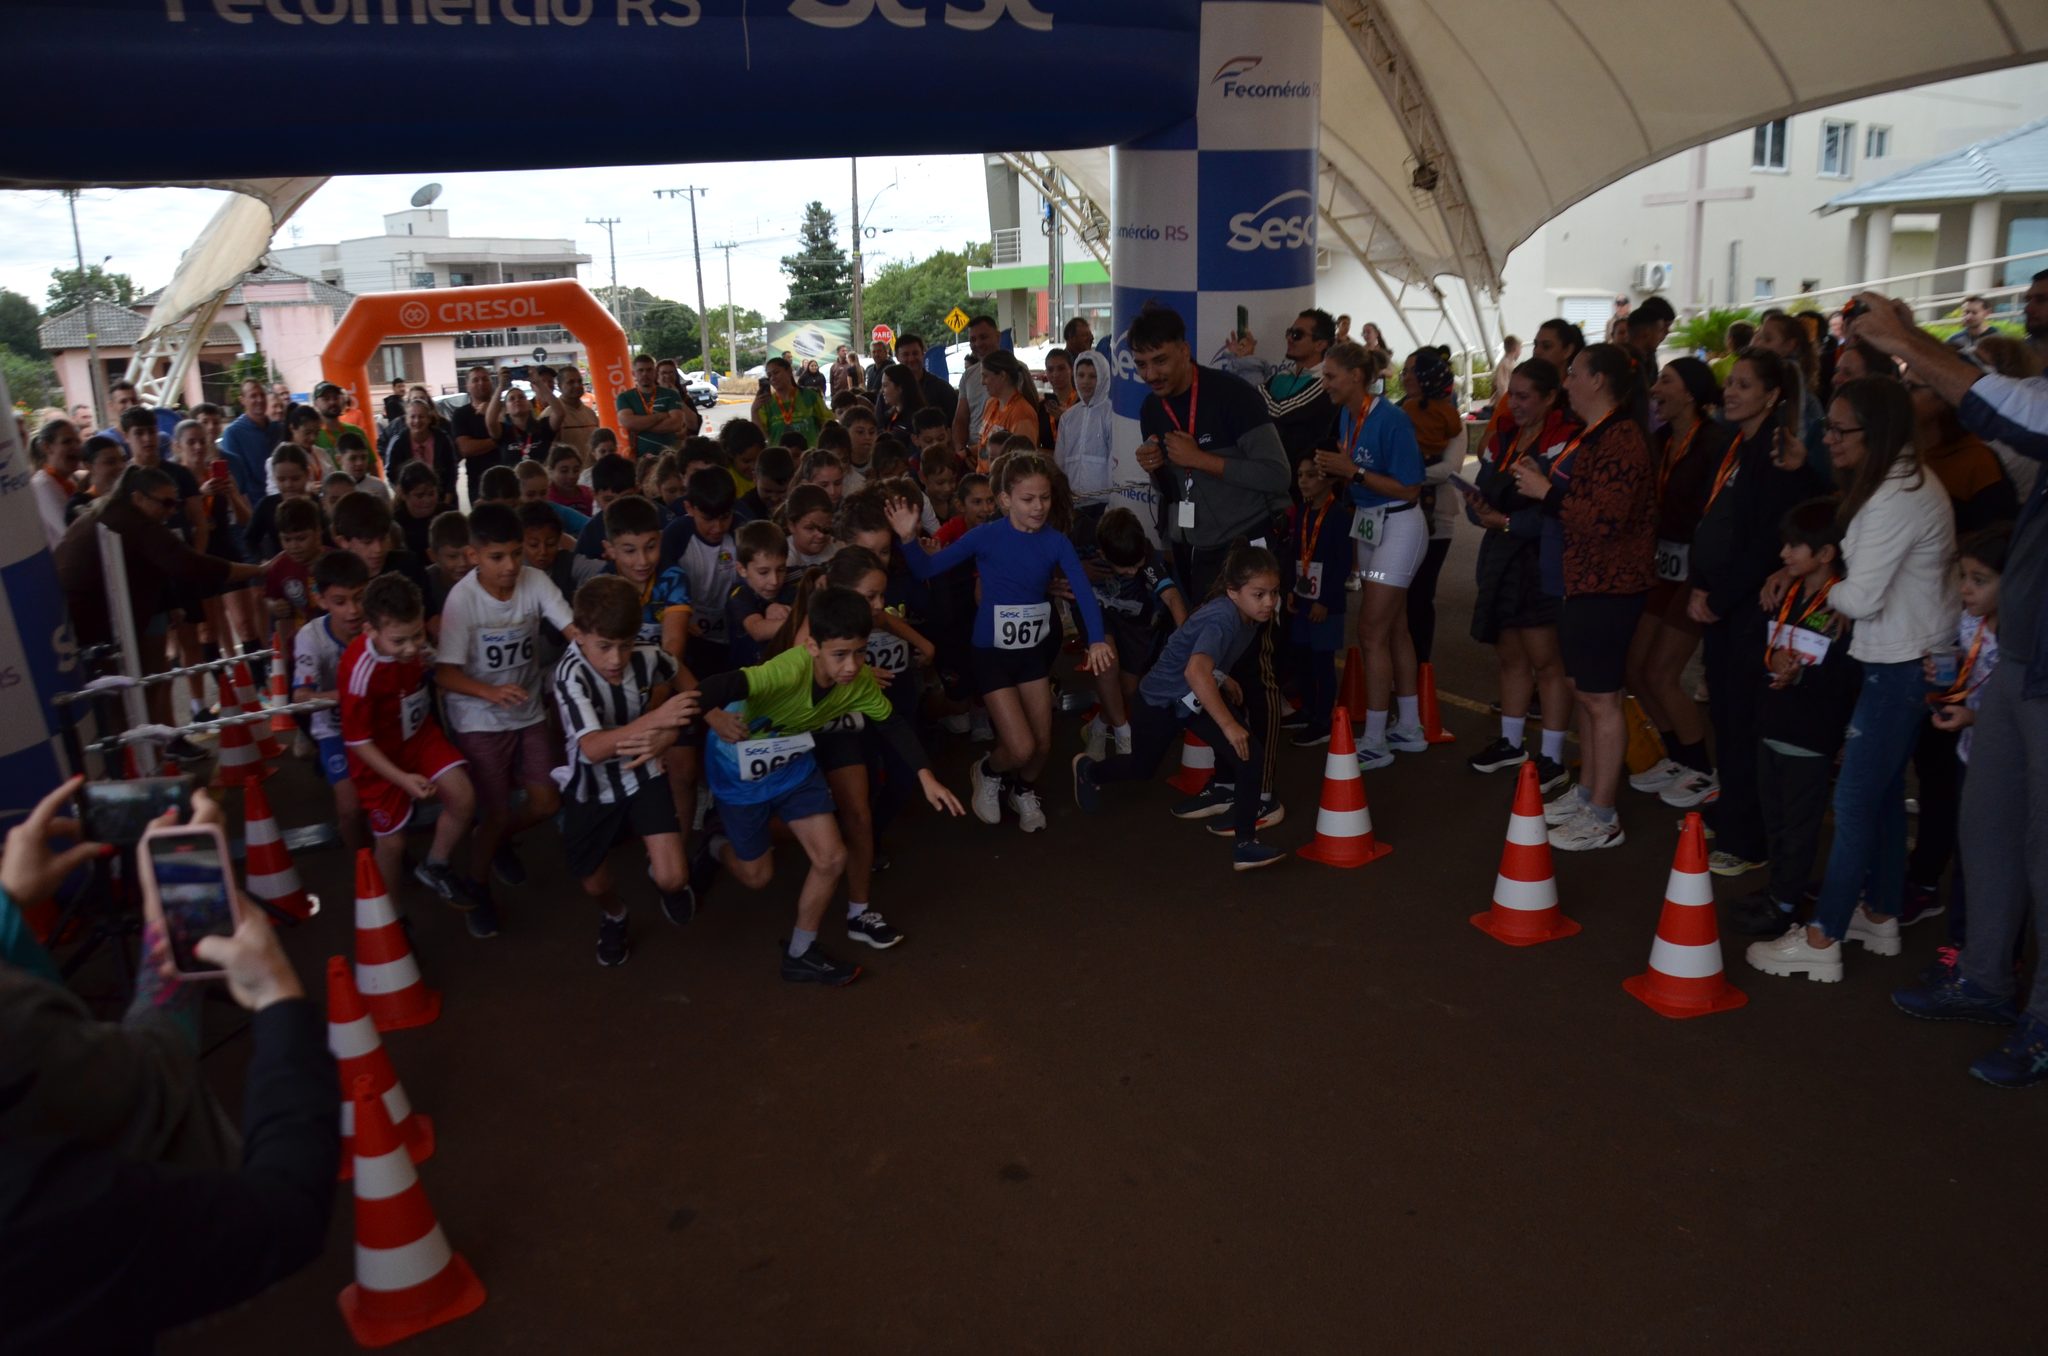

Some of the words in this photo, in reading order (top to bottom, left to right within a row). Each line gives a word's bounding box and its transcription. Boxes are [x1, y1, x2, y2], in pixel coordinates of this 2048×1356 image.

[1224, 81, 1310, 97] Fecomércio
[1165, 225, 1189, 241] RS
[438, 298, 545, 323] CRESOL
[1357, 517, 1374, 540] 48
[1002, 619, 1043, 646] 967
[486, 636, 533, 668] 976
